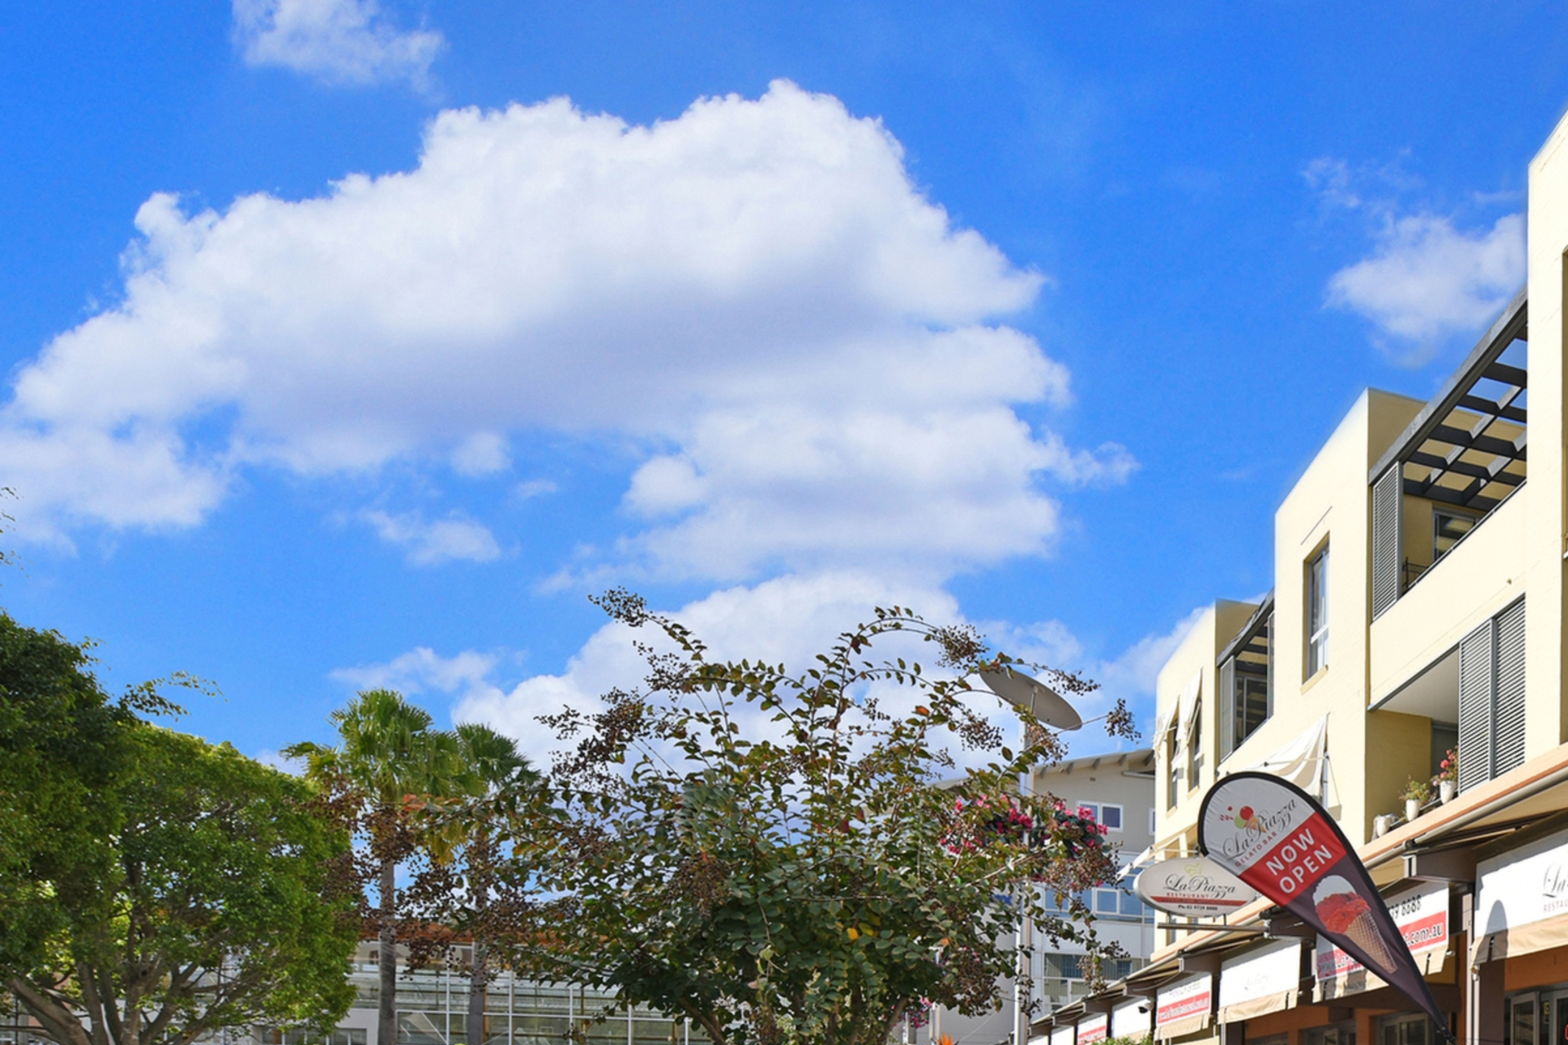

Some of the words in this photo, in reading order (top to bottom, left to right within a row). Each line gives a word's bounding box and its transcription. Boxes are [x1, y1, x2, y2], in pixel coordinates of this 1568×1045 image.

[1222, 832, 1252, 860] La
[1246, 799, 1297, 840] Piazza
[1234, 843, 1263, 867] GELATO
[1263, 831, 1277, 847] BAR
[1265, 828, 1315, 876] NOW
[1279, 844, 1333, 894] OPEN
[1163, 874, 1187, 892] La
[1188, 875, 1236, 898] Piazza
[1542, 861, 1566, 898] La
